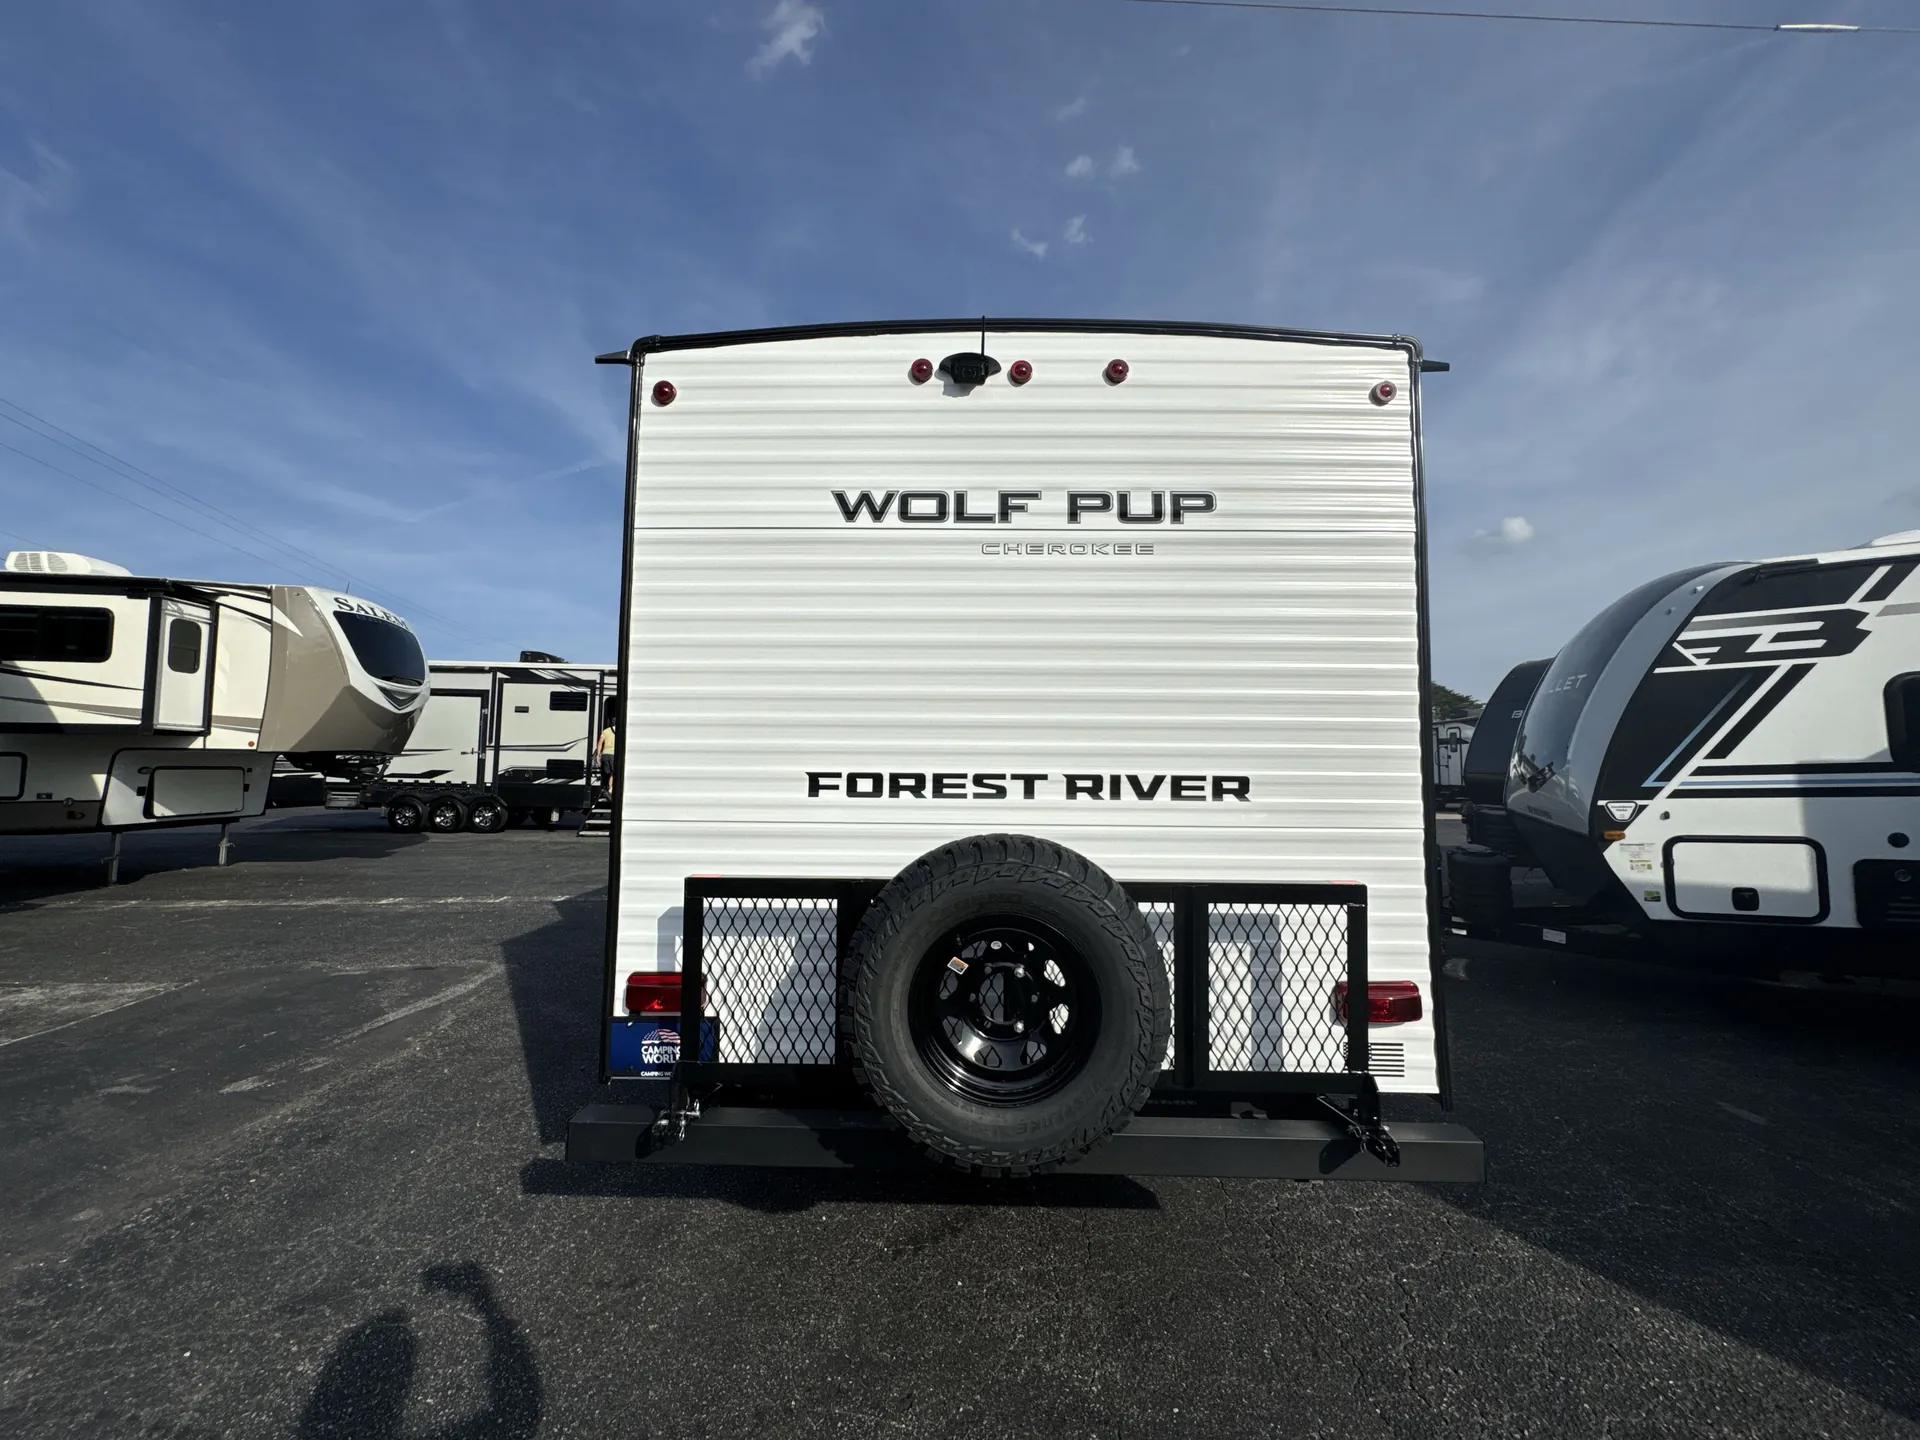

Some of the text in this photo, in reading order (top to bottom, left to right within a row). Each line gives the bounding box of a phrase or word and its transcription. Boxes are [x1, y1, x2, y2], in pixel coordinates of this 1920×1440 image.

[831, 490, 1217, 525] WOLF PUP
[981, 542, 1155, 556] CHEROKEE
[333, 597, 410, 630] SALEM
[805, 771, 1252, 802] FOREST RIVER
